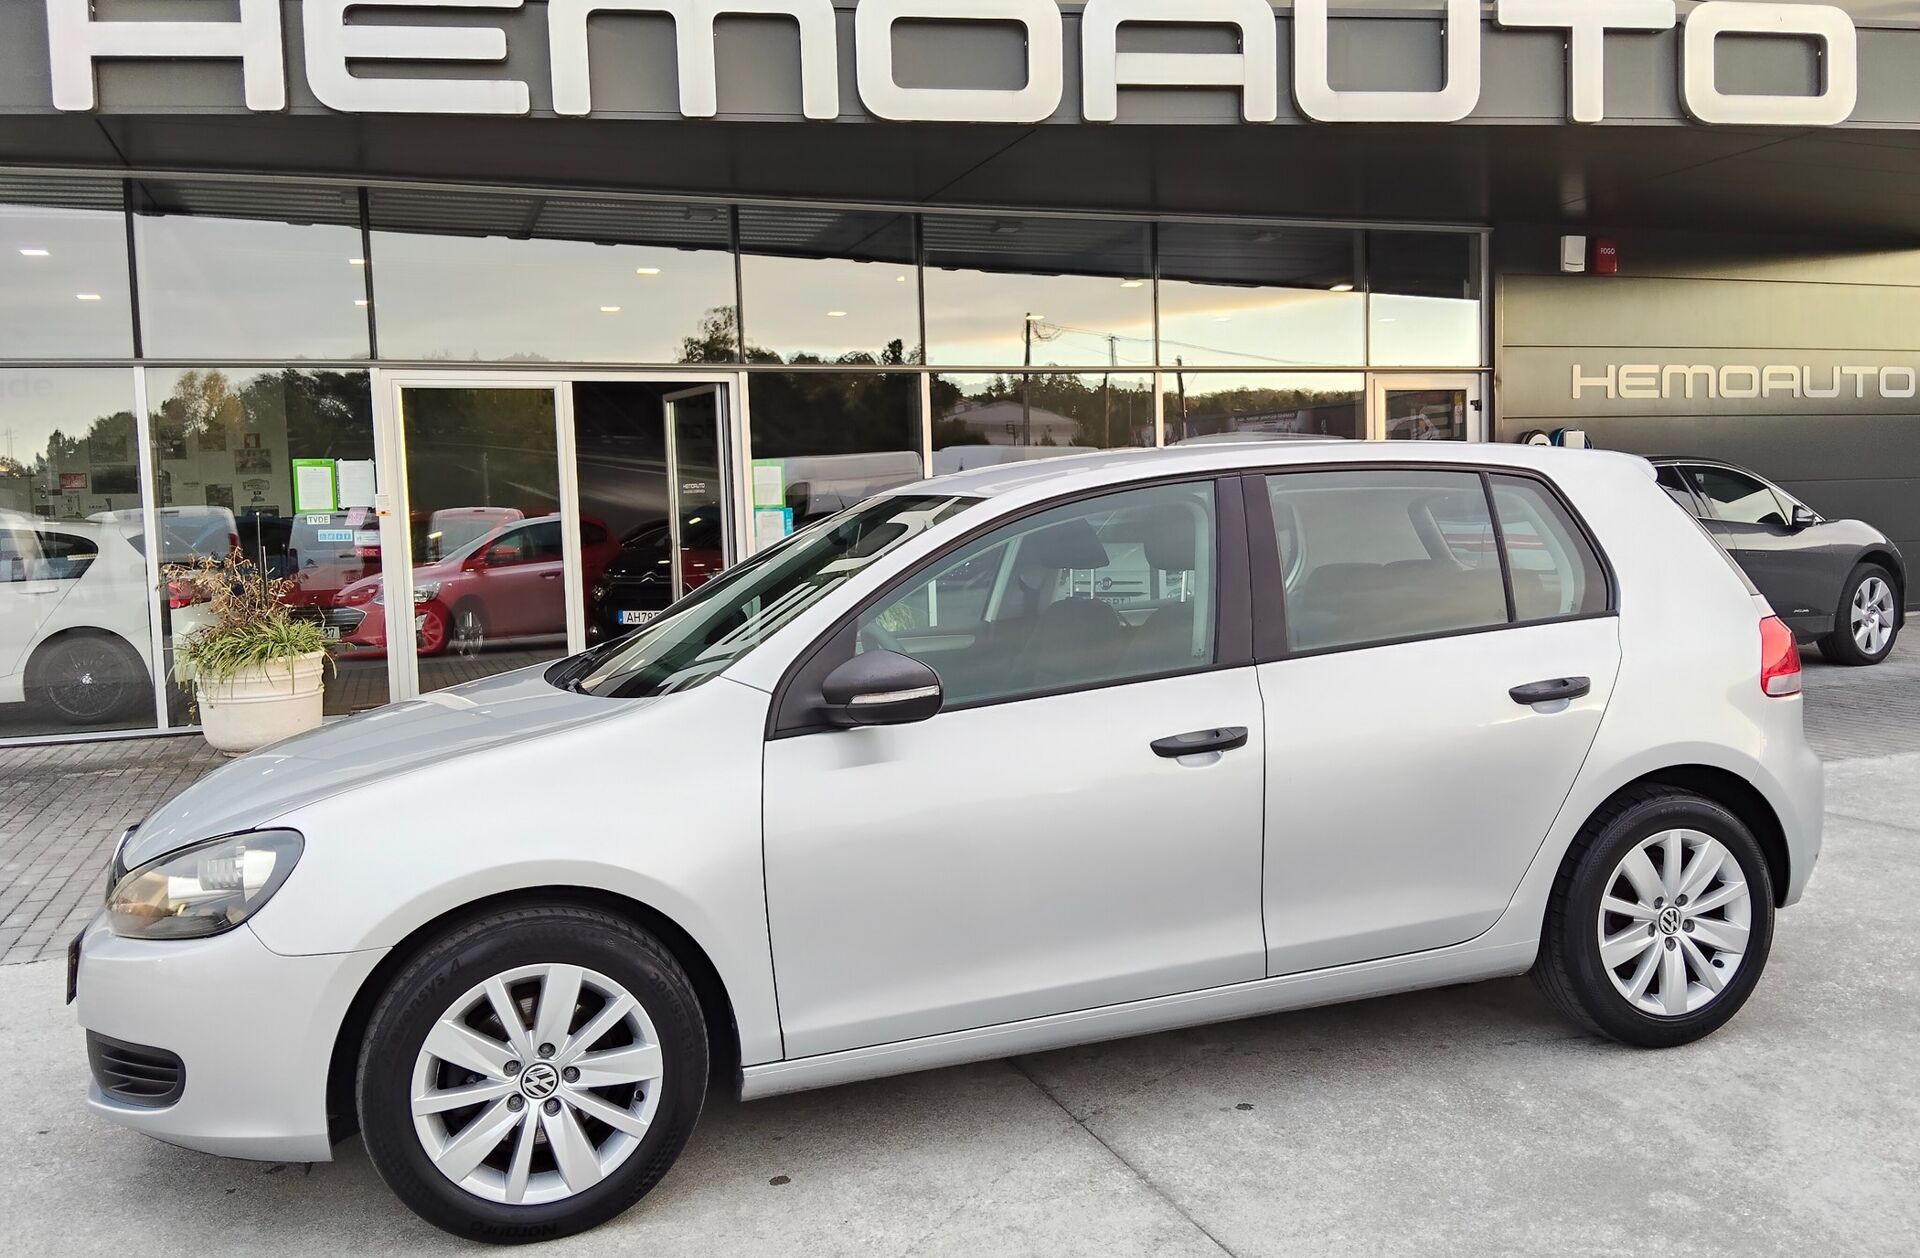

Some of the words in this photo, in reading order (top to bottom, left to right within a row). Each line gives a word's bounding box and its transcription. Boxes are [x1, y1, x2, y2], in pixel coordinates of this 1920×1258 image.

[48, 0, 1858, 125] HEMOAUTO
[1600, 247, 1616, 255] FOGO
[1572, 363, 1915, 399] HEMOAUTO
[308, 516, 329, 524] TVDE
